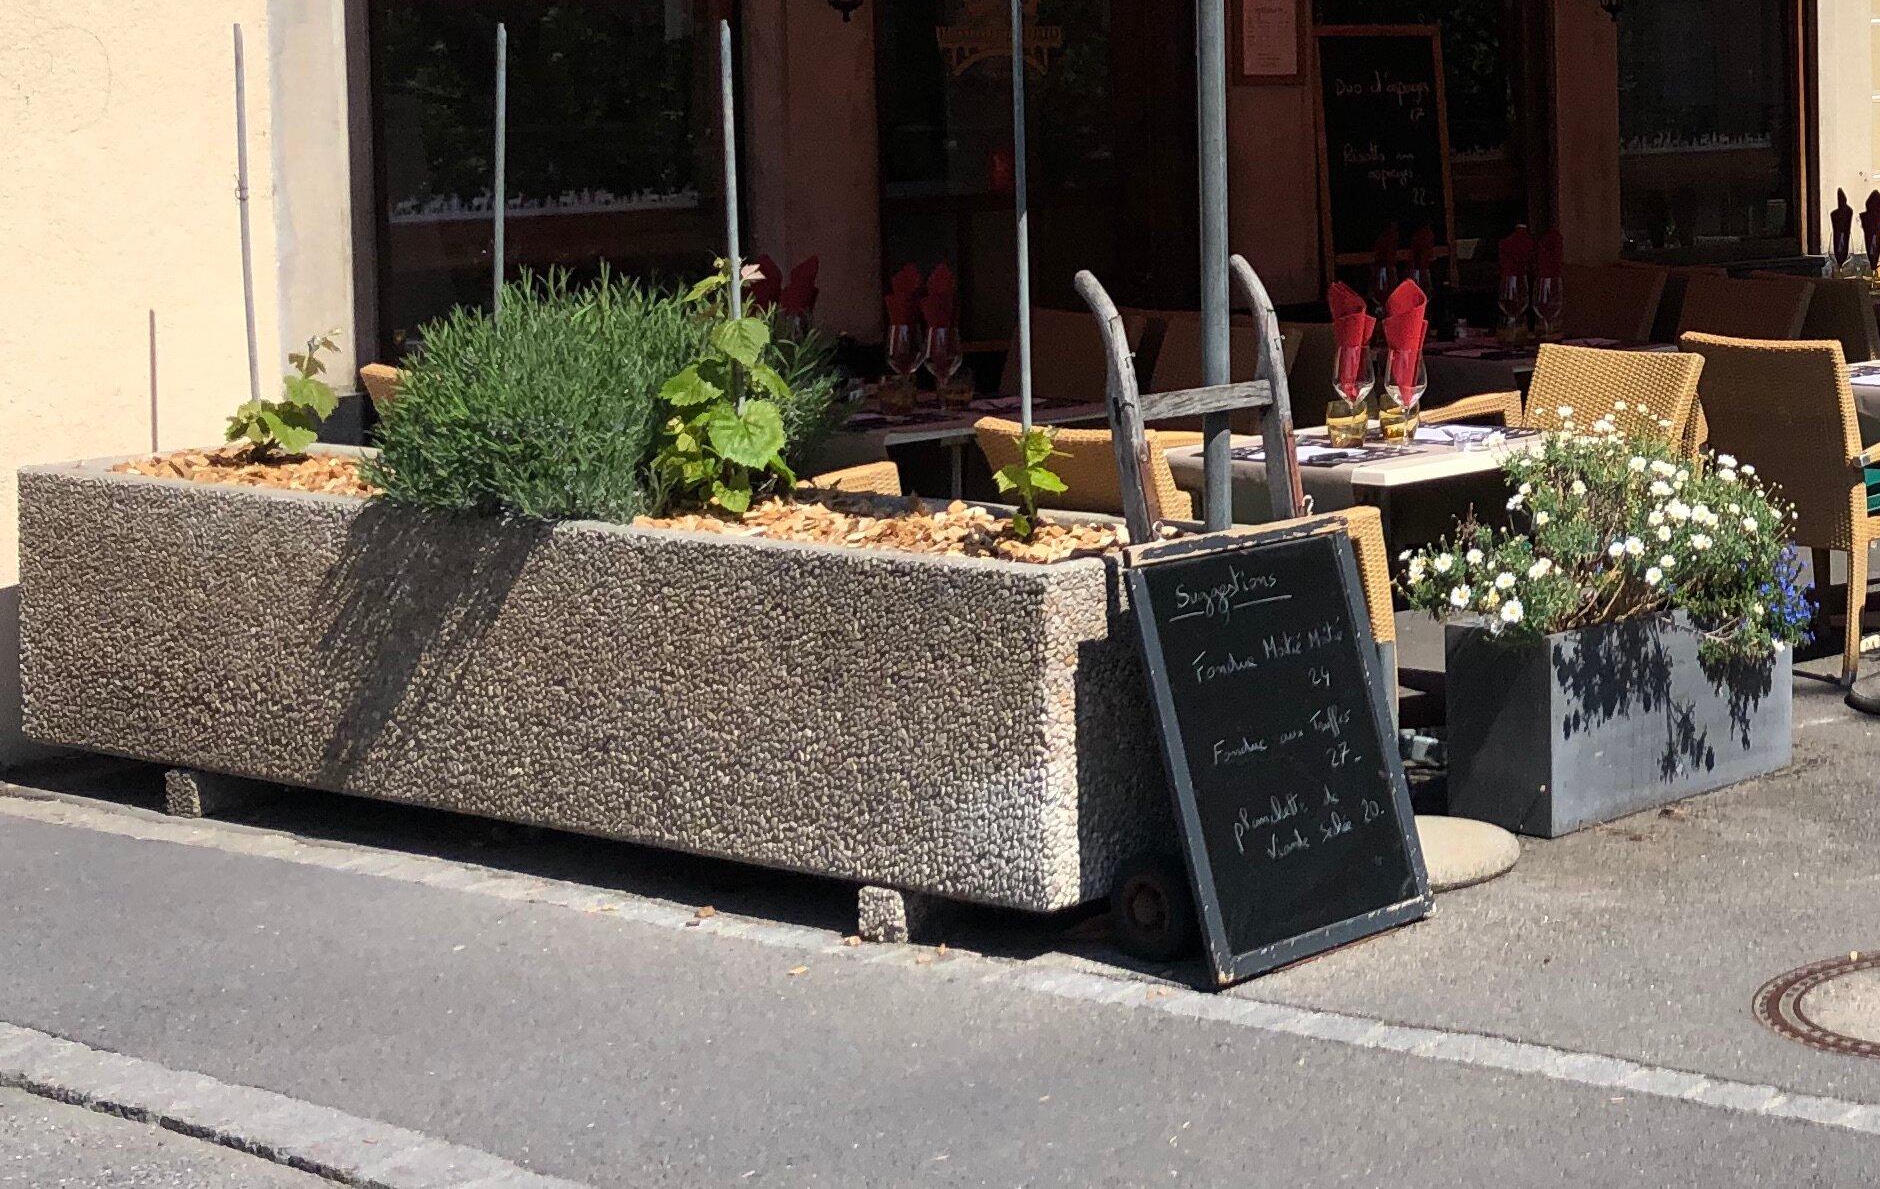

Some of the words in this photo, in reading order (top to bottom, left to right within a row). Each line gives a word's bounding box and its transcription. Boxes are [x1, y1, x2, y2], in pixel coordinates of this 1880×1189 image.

[1175, 565, 1277, 625] Suggestions
[1192, 651, 1258, 683] Fondue
[1308, 666, 1330, 687] 24
[1213, 737, 1268, 766] Fondue
